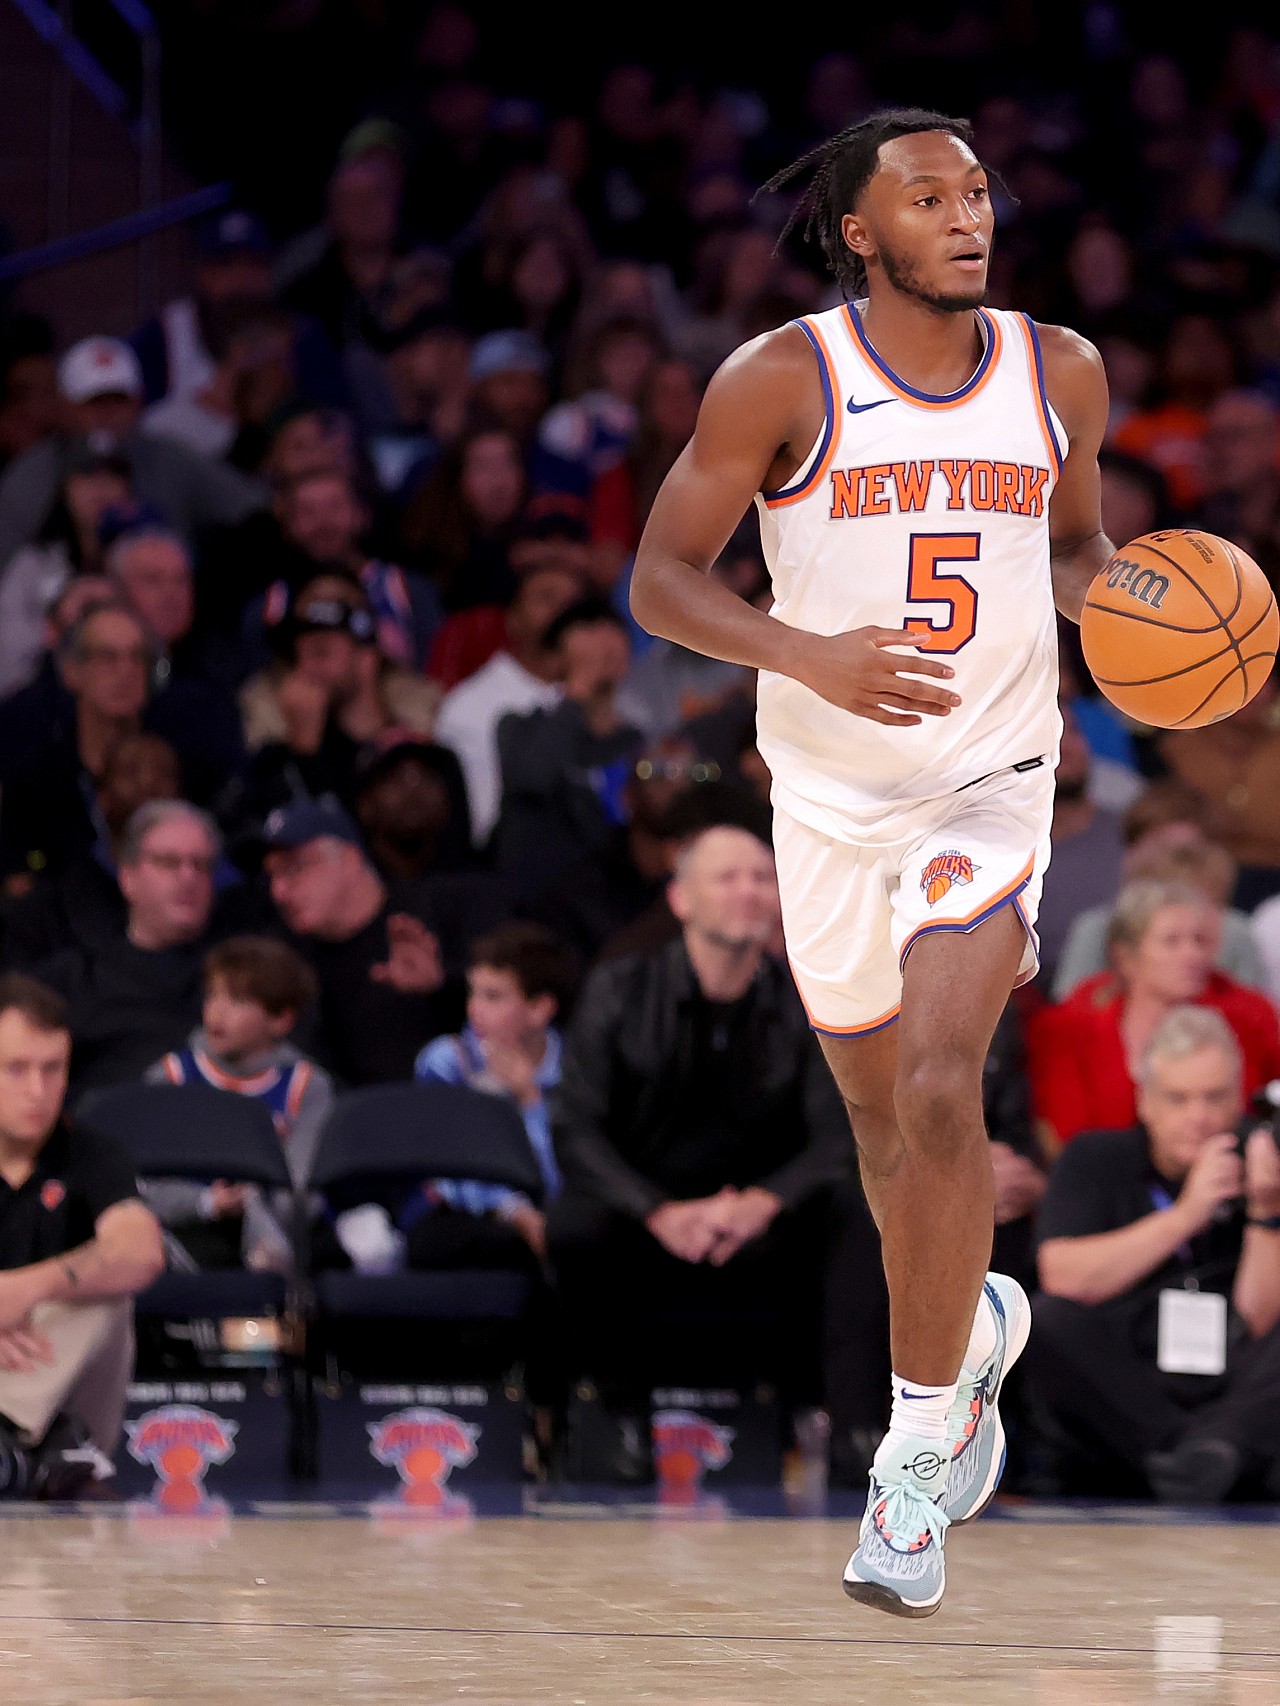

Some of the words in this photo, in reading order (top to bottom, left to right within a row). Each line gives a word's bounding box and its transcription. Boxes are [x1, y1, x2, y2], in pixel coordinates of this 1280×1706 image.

[830, 459, 935, 519] NEW
[938, 459, 1050, 519] YORK
[903, 532, 982, 655] 5
